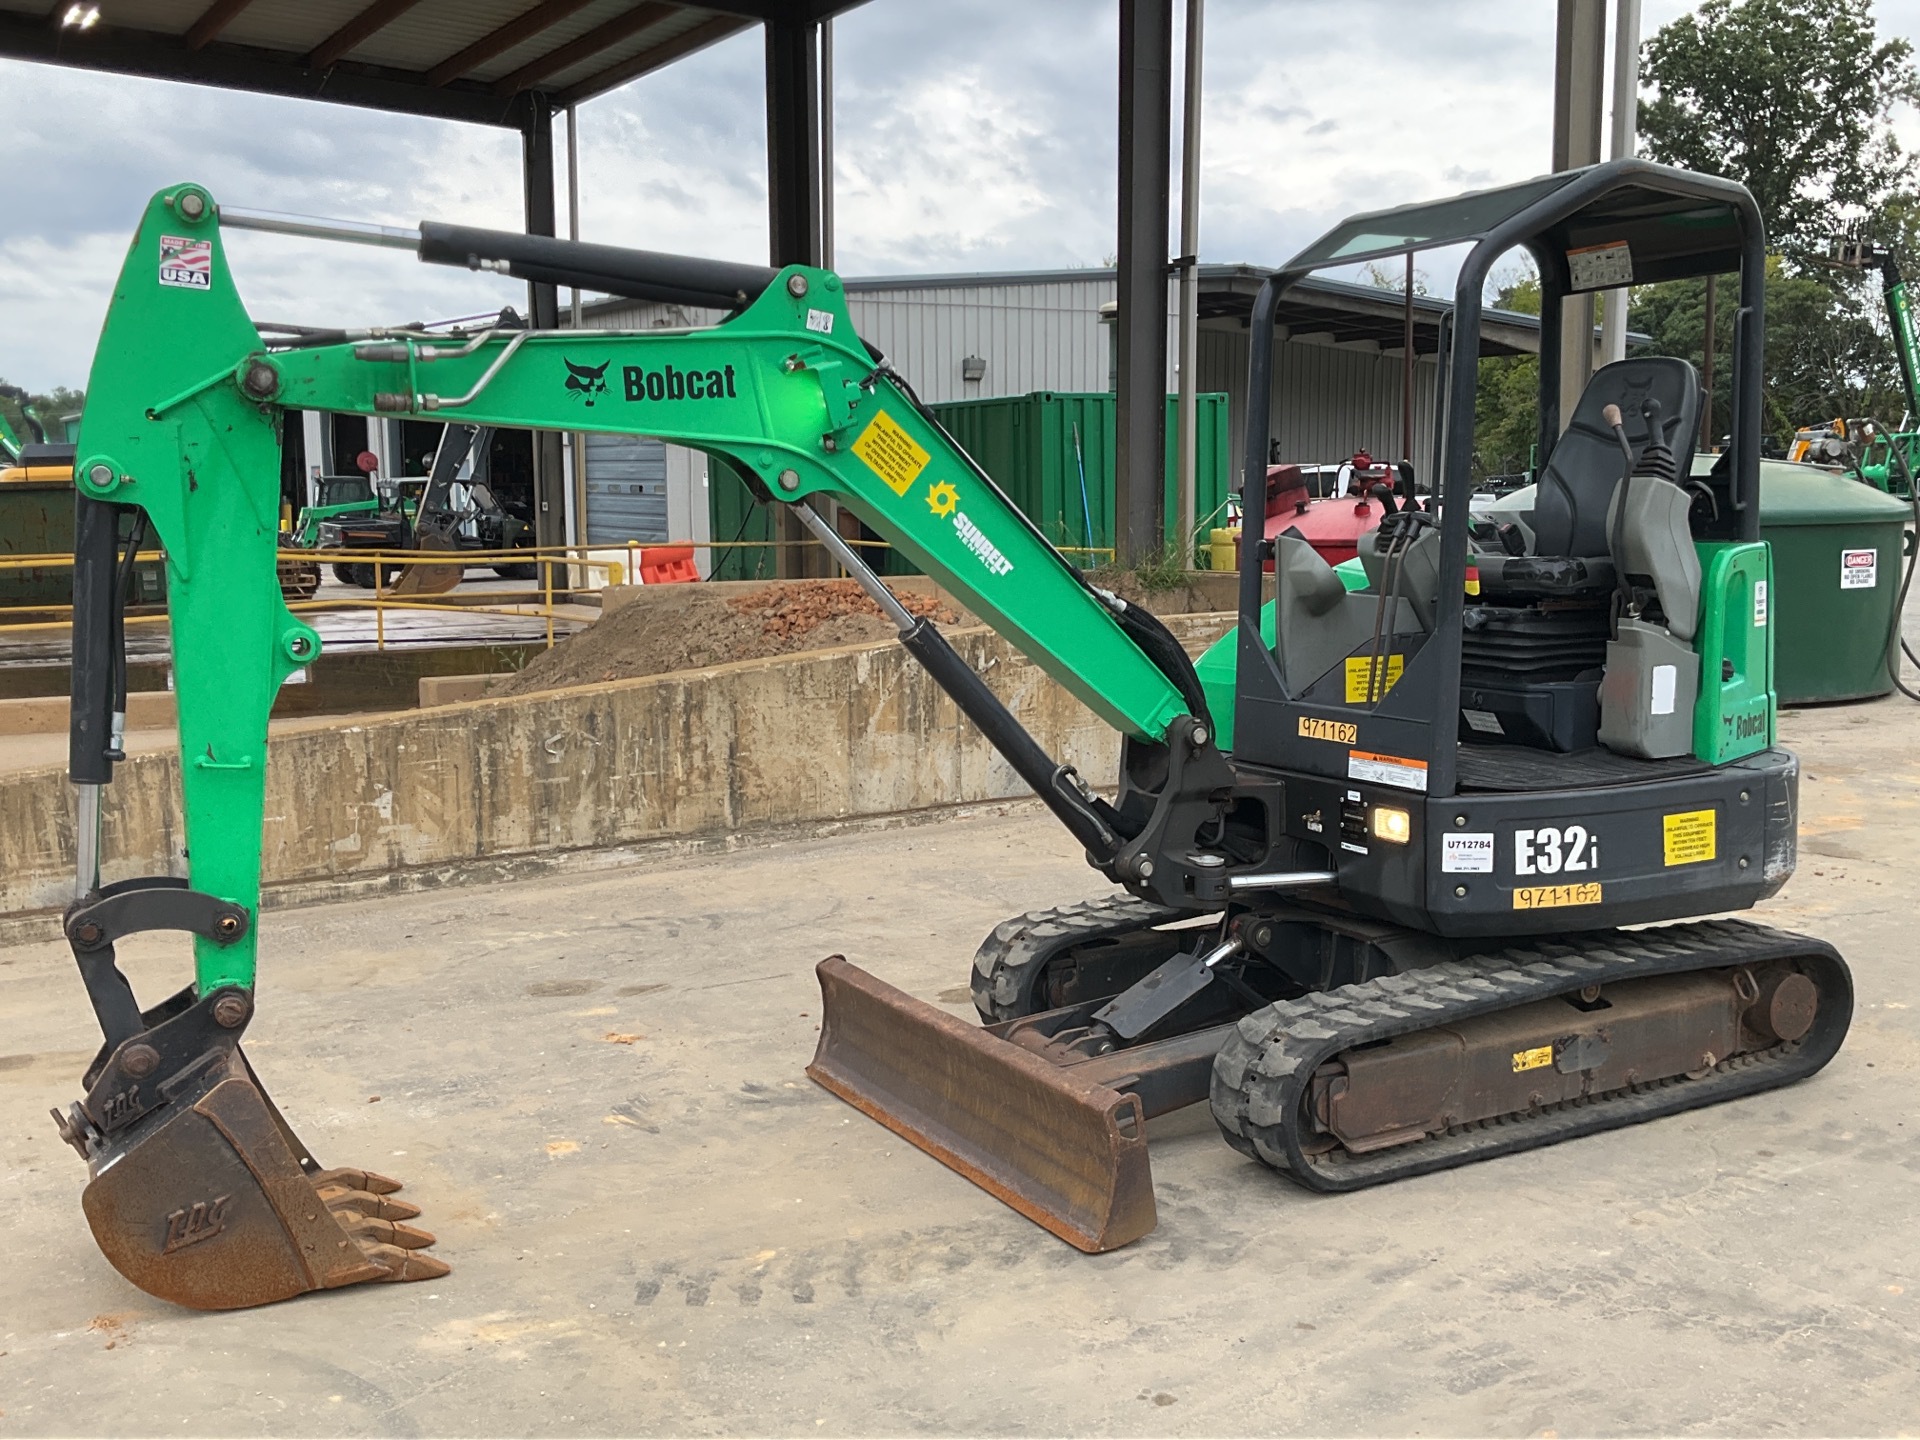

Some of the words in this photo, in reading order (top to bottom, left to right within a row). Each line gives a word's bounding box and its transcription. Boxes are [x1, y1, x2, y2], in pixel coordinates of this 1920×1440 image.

[163, 268, 207, 284] USA
[623, 364, 737, 402] Bobcat
[872, 438, 887, 455] WITHIN
[887, 452, 896, 463] TEN
[895, 461, 908, 473] FEET
[873, 420, 896, 444] UNLAWFUL
[896, 442, 903, 451] TO
[902, 447, 923, 470] OPERATE
[876, 433, 887, 445] THIS
[886, 443, 912, 467] EQUIPMENT
[892, 429, 913, 450] WARNING
[864, 441, 872, 449] OF
[871, 448, 895, 472] OVERHEAD
[894, 469, 906, 482] HIGH
[865, 451, 885, 471] VOLTAGE
[884, 469, 898, 484] LINES
[952, 511, 1014, 576] SUNBELT
[955, 530, 997, 574] RENTALS
[1847, 556, 1872, 565] DANGER
[1302, 718, 1356, 743] 971162
[1736, 709, 1765, 740] Bobcat
[1378, 756, 1402, 764] WARNING
[1447, 840, 1491, 849] U712784
[1515, 825, 1597, 875] E32i
[1519, 885, 1600, 908] 971162
